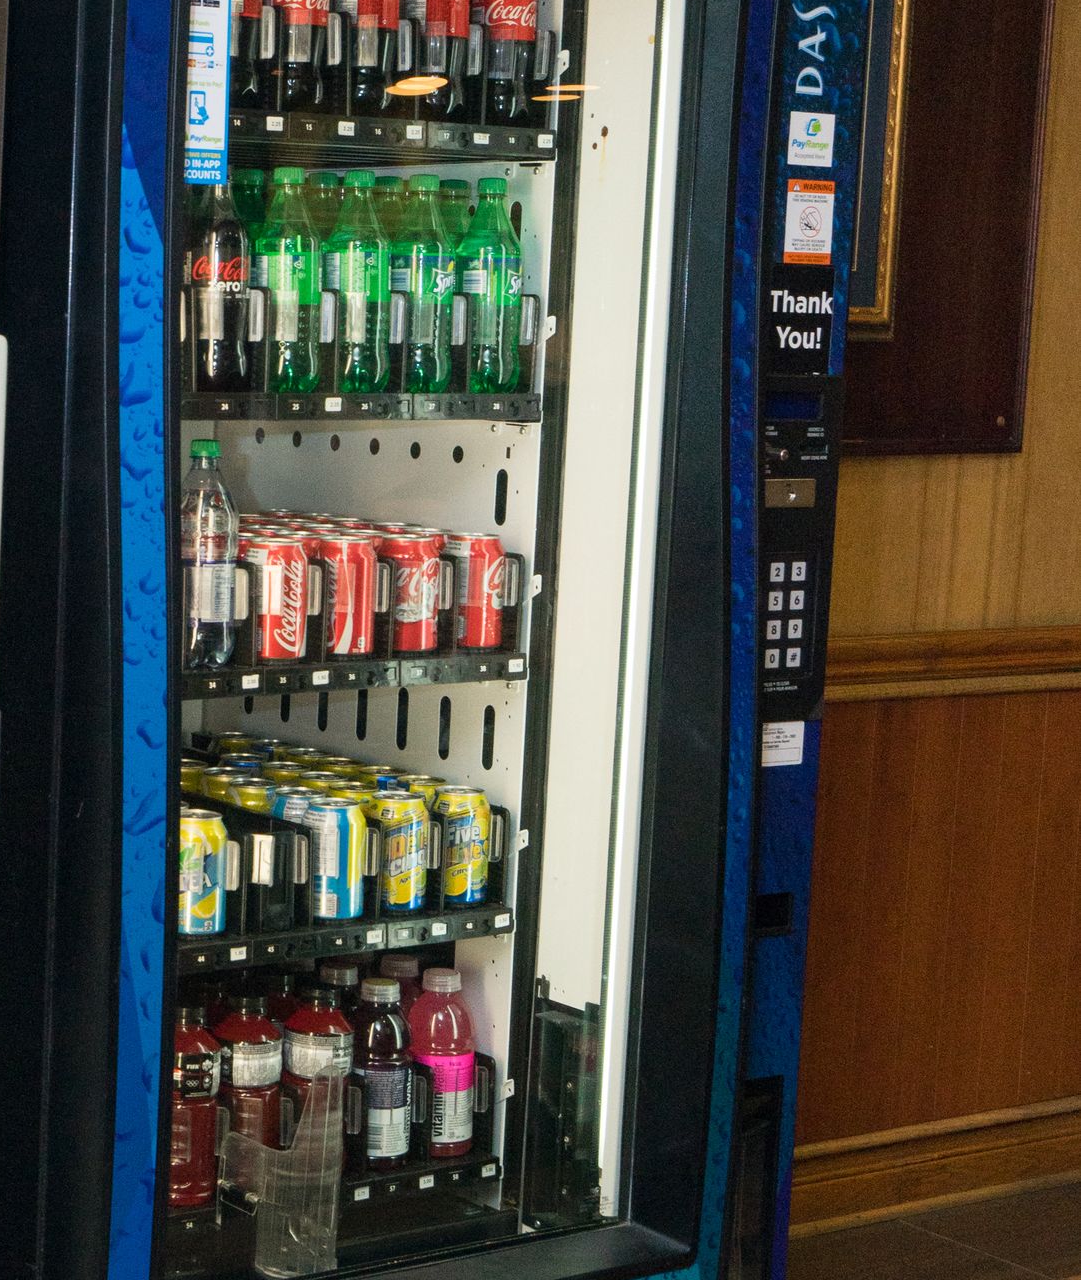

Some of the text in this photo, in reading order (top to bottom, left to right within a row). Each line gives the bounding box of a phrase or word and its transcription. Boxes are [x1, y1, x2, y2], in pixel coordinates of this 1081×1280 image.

[306, 123, 313, 131] 15
[792, 139, 830, 150] PayRange
[192, 159, 221, 168] IN-APP
[185, 169, 221, 180] COUNTS
[803, 183, 833, 192] WARNING
[771, 290, 833, 314] Thank
[776, 326, 822, 350] You!
